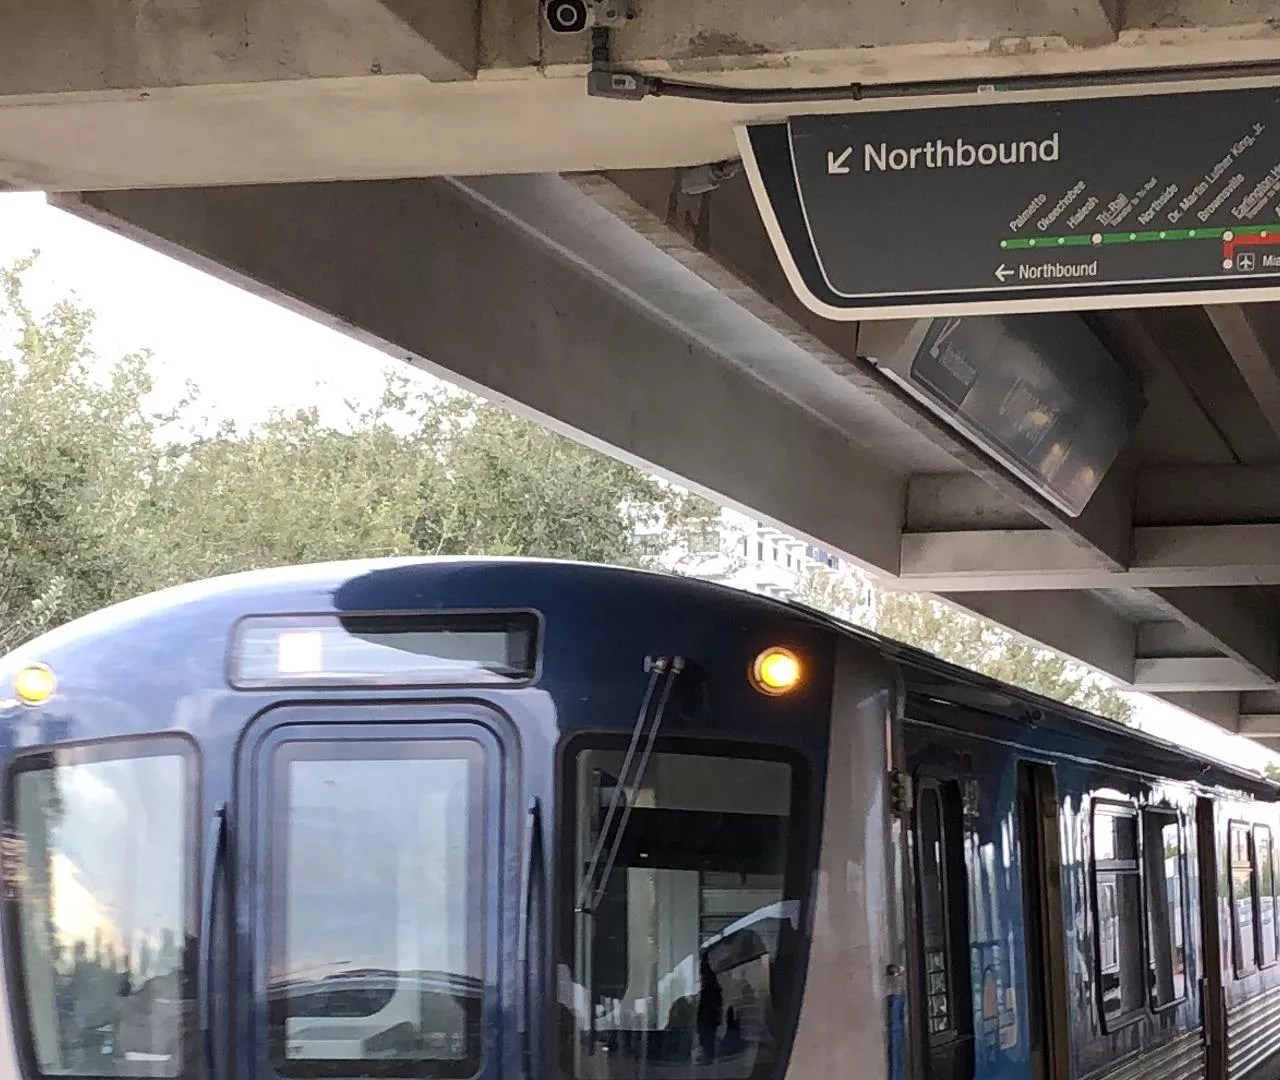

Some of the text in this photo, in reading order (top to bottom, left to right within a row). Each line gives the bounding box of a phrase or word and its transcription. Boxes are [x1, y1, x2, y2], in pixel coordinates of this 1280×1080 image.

[863, 132, 1061, 173] Northbound
[1180, 181, 1207, 209] Martin
[1206, 154, 1233, 182] Luther
[1198, 173, 1244, 220] Brownsville
[1009, 192, 1046, 230] Palmetto
[1037, 180, 1085, 230] Okeechobee
[1139, 183, 1178, 223] Northside
[1018, 261, 1098, 279] Northbound
